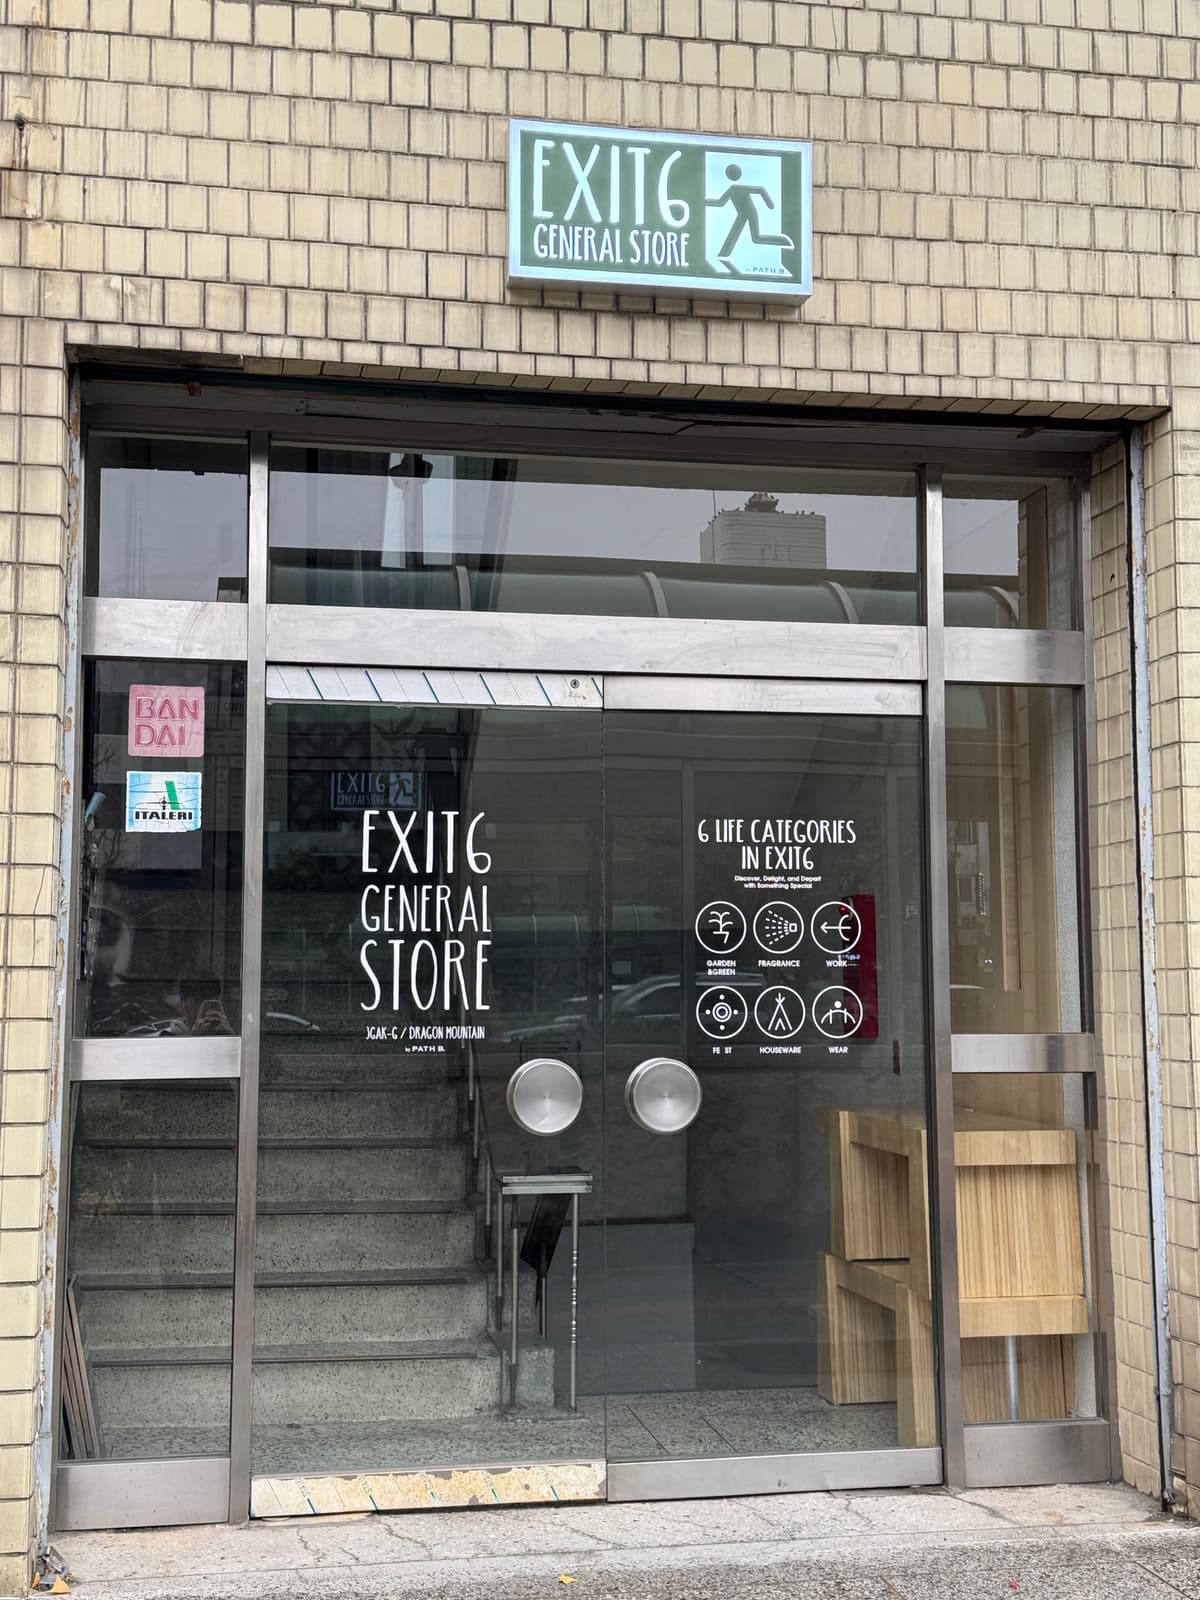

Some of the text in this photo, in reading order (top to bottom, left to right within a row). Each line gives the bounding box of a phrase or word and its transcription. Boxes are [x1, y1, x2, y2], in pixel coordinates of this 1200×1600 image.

[533, 138, 690, 228] EXIT6
[533, 223, 690, 267] GENERAL STORE
[135, 696, 199, 720] BAN
[135, 723, 186, 747] DAI
[134, 810, 193, 821] ITALERI
[361, 810, 492, 874] EXIT6
[697, 819, 857, 843] 6 LIFE CATEGORIES
[741, 846, 814, 870] IN EXIT6
[361, 884, 492, 933] GENERAL
[360, 939, 492, 1011] STORE
[706, 959, 737, 967] GARDEN
[707, 968, 736, 976] &GREEN
[758, 959, 801, 967] FRAGRANCE
[825, 959, 848, 967] WORK
[409, 1026, 444, 1040] DRAGON
[445, 1026, 486, 1040] MOUNTAIN
[759, 1046, 802, 1054] HOUSEWARE
[828, 1046, 849, 1054] WEAR
